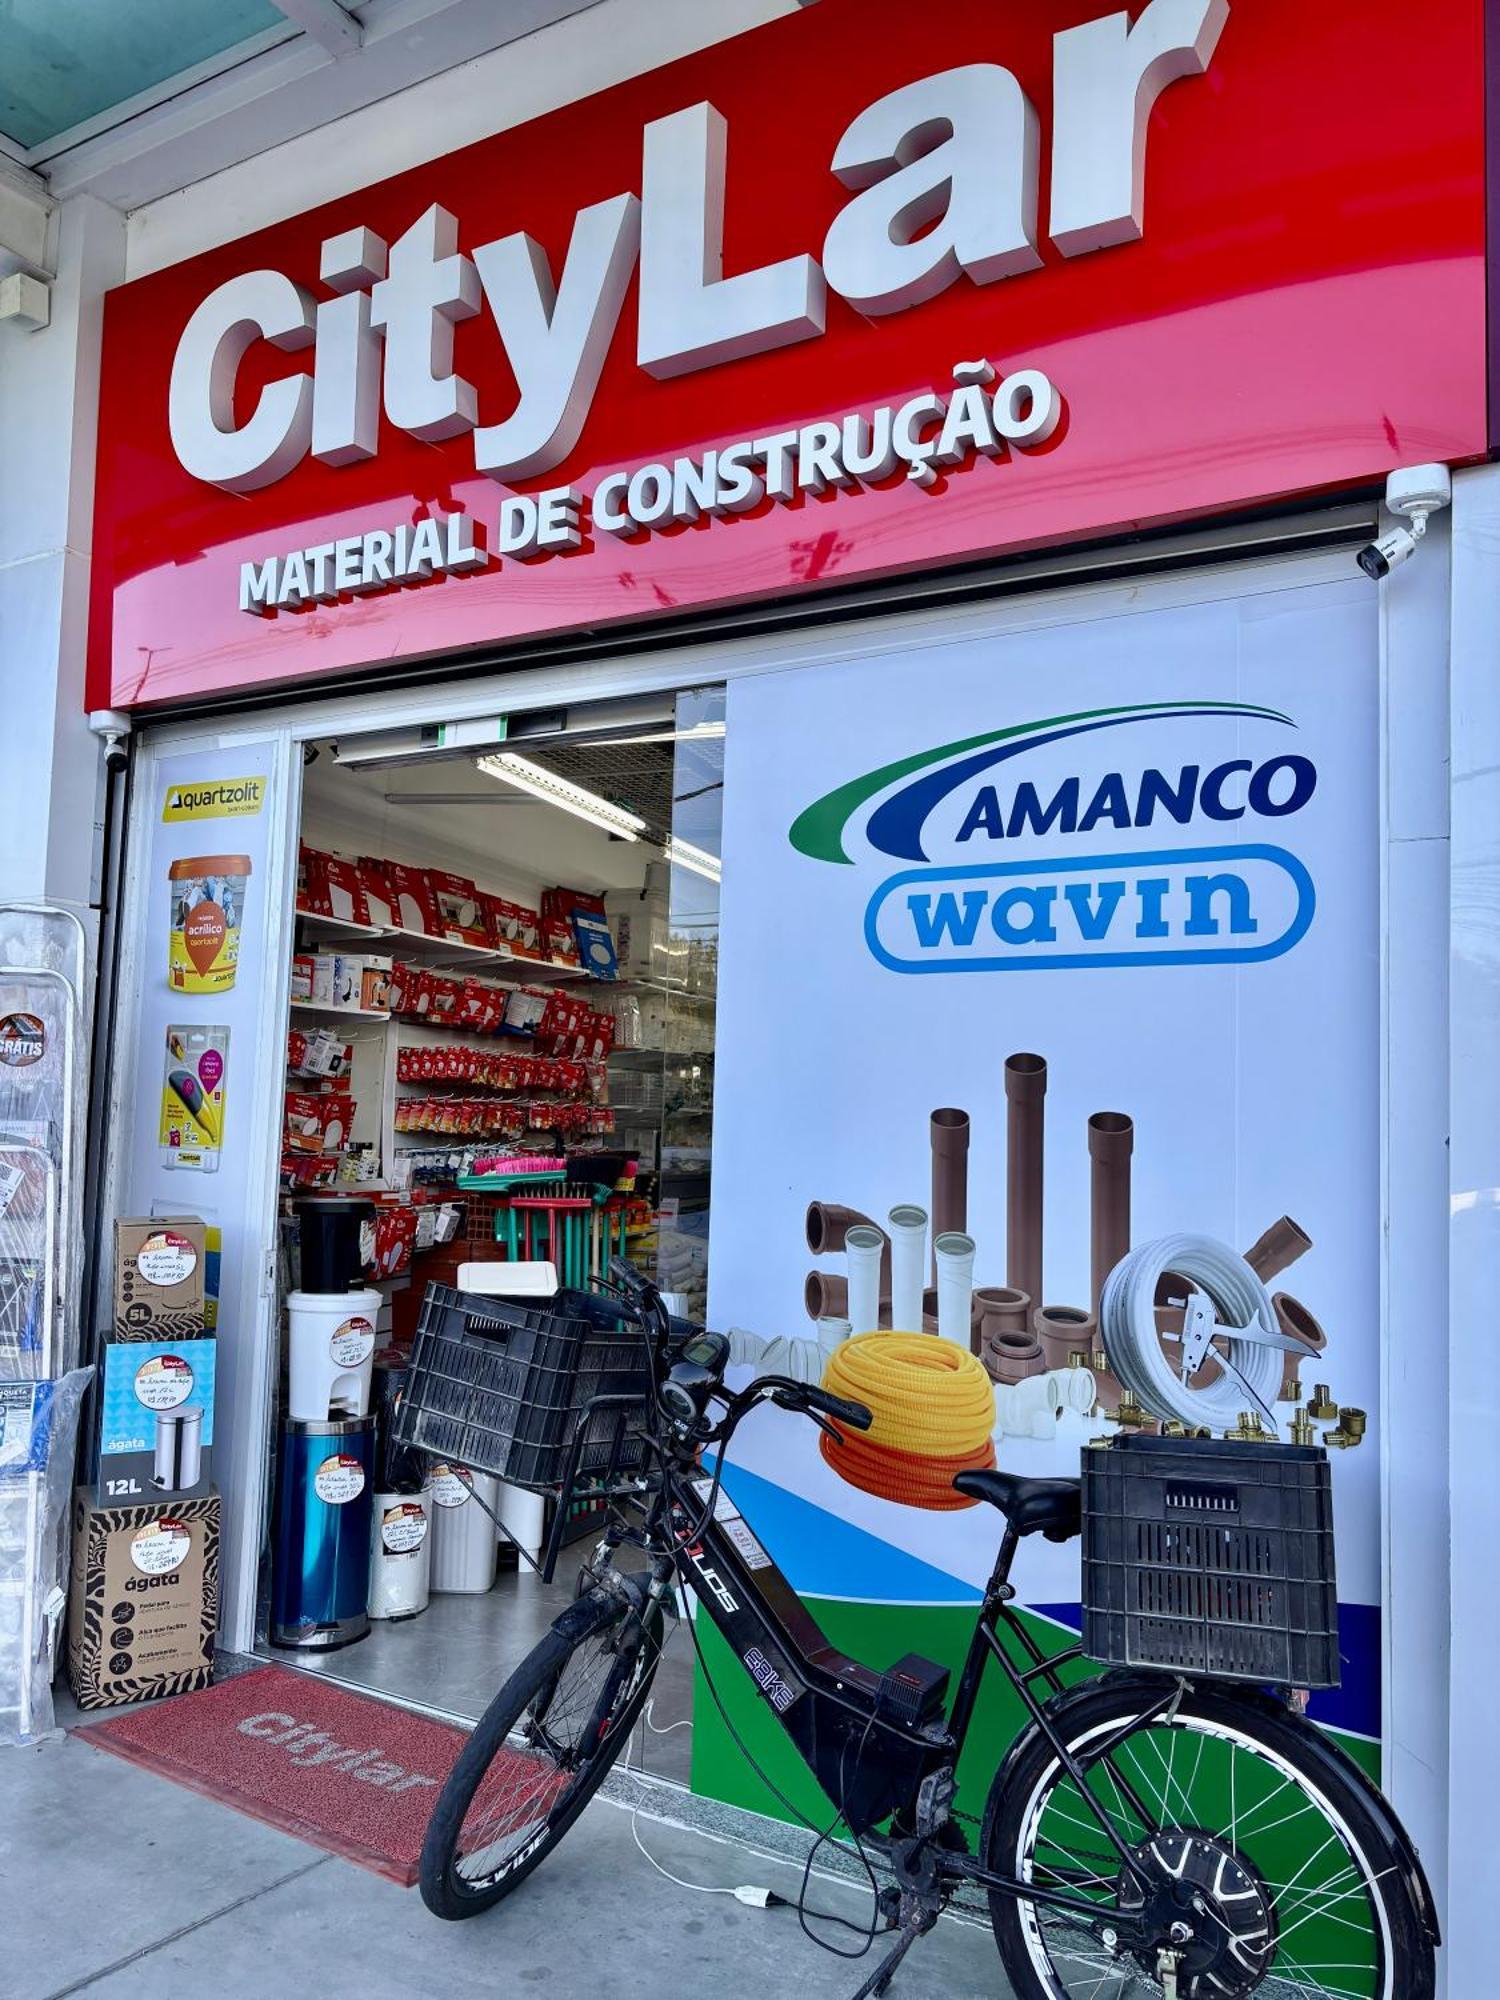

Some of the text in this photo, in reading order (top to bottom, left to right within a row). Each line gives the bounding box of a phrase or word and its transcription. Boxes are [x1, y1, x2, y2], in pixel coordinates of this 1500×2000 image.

[169, 0, 1230, 491] CityLar
[239, 359, 1061, 614] MATERIAL DE CONSTRUÇÃO
[183, 782, 259, 810] quartzolit
[955, 755, 1317, 842] AMANCO
[907, 873, 1258, 947] wavin
[189, 923, 222, 936] acrílico
[130, 1309, 149, 1321] 5L
[108, 1438, 145, 1452] ágata
[106, 1479, 142, 1496] 12L
[125, 1574, 179, 1592] ágata
